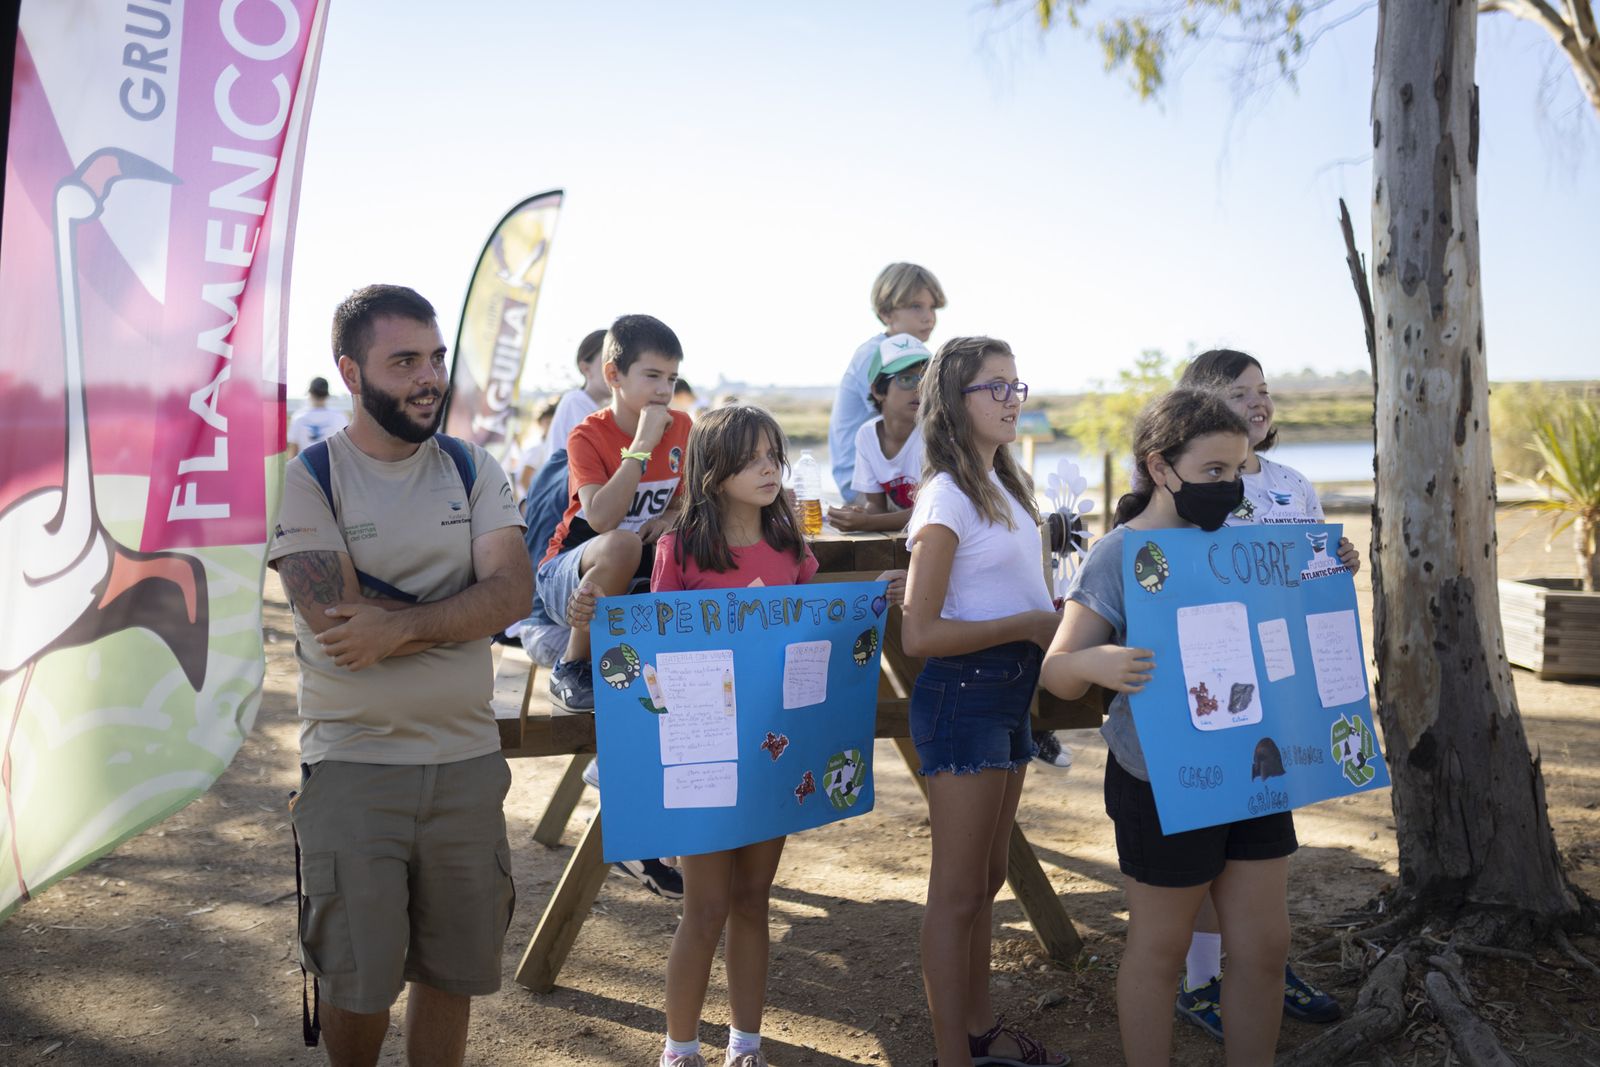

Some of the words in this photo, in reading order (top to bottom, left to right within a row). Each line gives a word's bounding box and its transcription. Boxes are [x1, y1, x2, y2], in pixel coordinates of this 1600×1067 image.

[119, 0, 172, 122] GRU
[167, 0, 300, 523] FLAMENCO
[1208, 541, 1300, 588] COBRE
[1301, 569, 1328, 581] ATLANTIC
